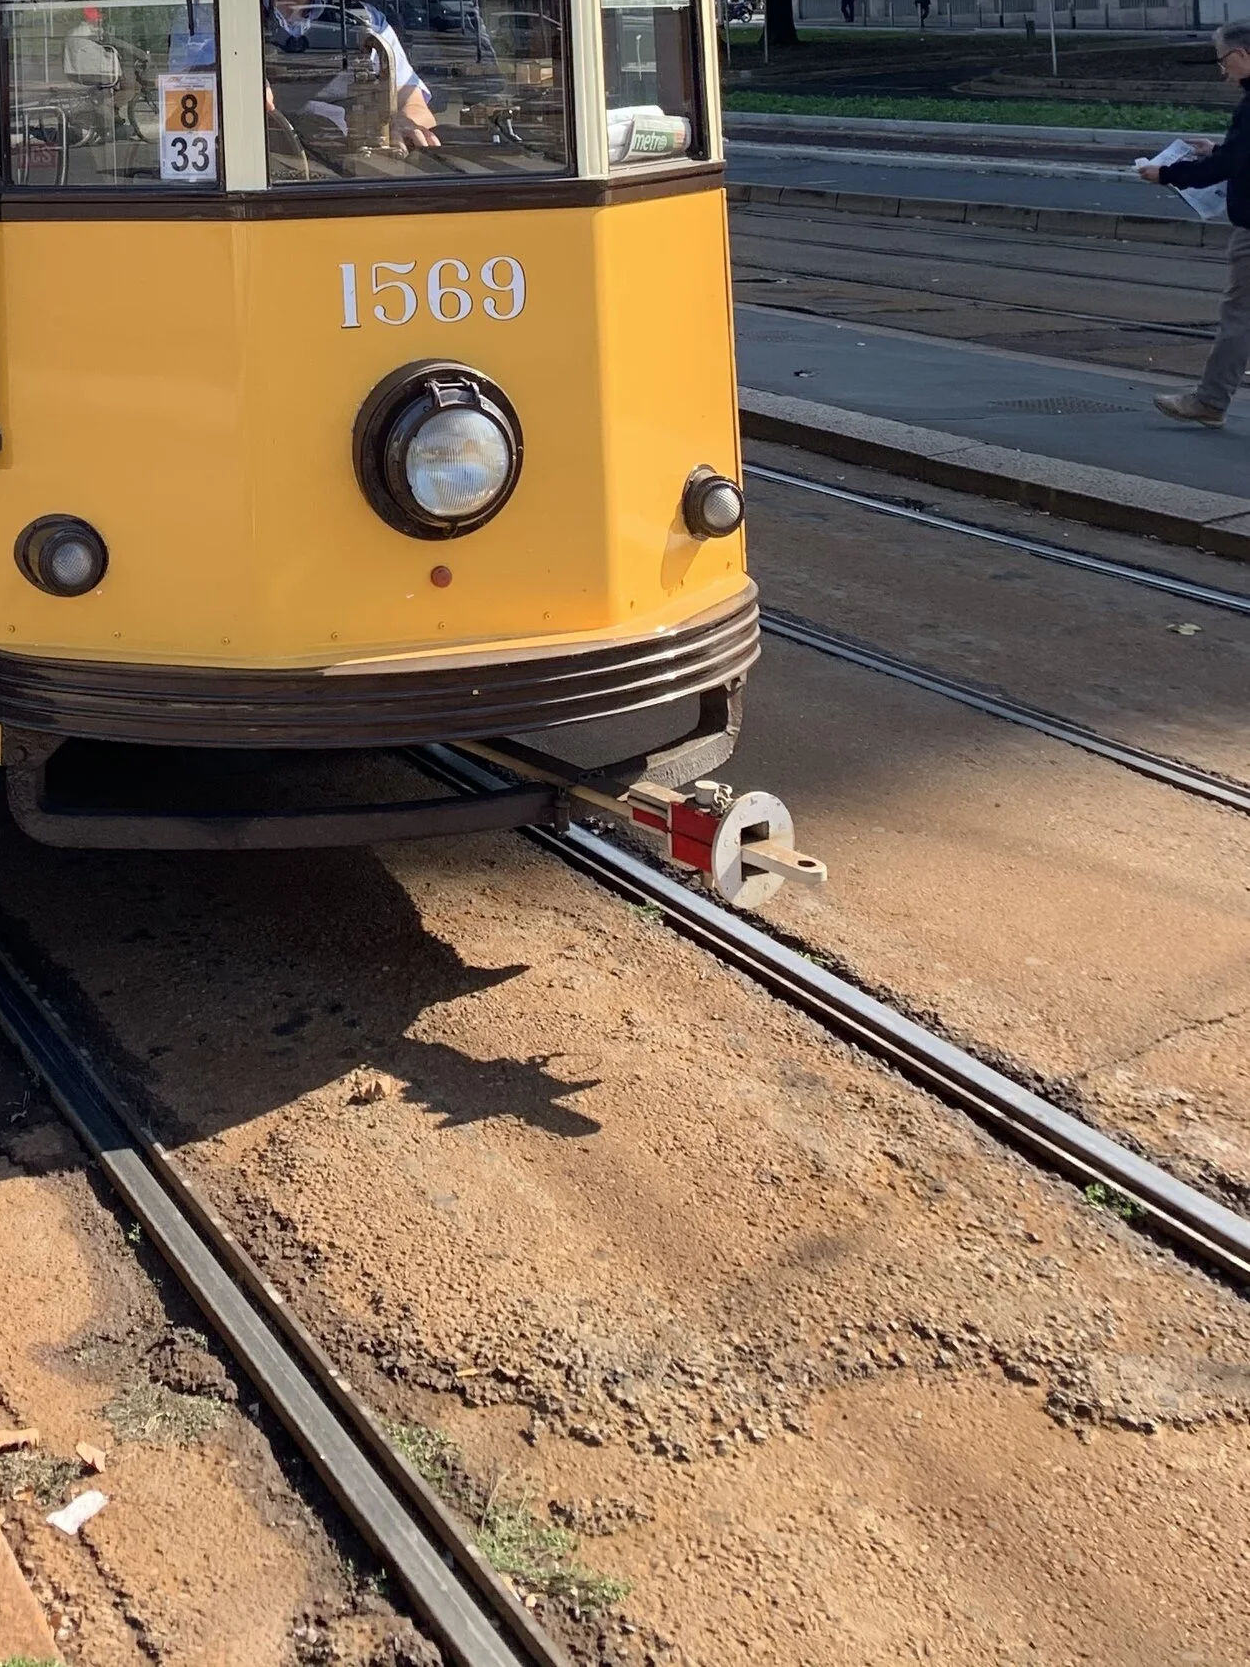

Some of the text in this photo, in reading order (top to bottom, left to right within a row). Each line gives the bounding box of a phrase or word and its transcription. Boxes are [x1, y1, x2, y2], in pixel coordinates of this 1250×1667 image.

[180, 93, 199, 129] 8
[170, 136, 210, 172] 33
[632, 132, 668, 151] metro
[338, 254, 527, 329] 1569
